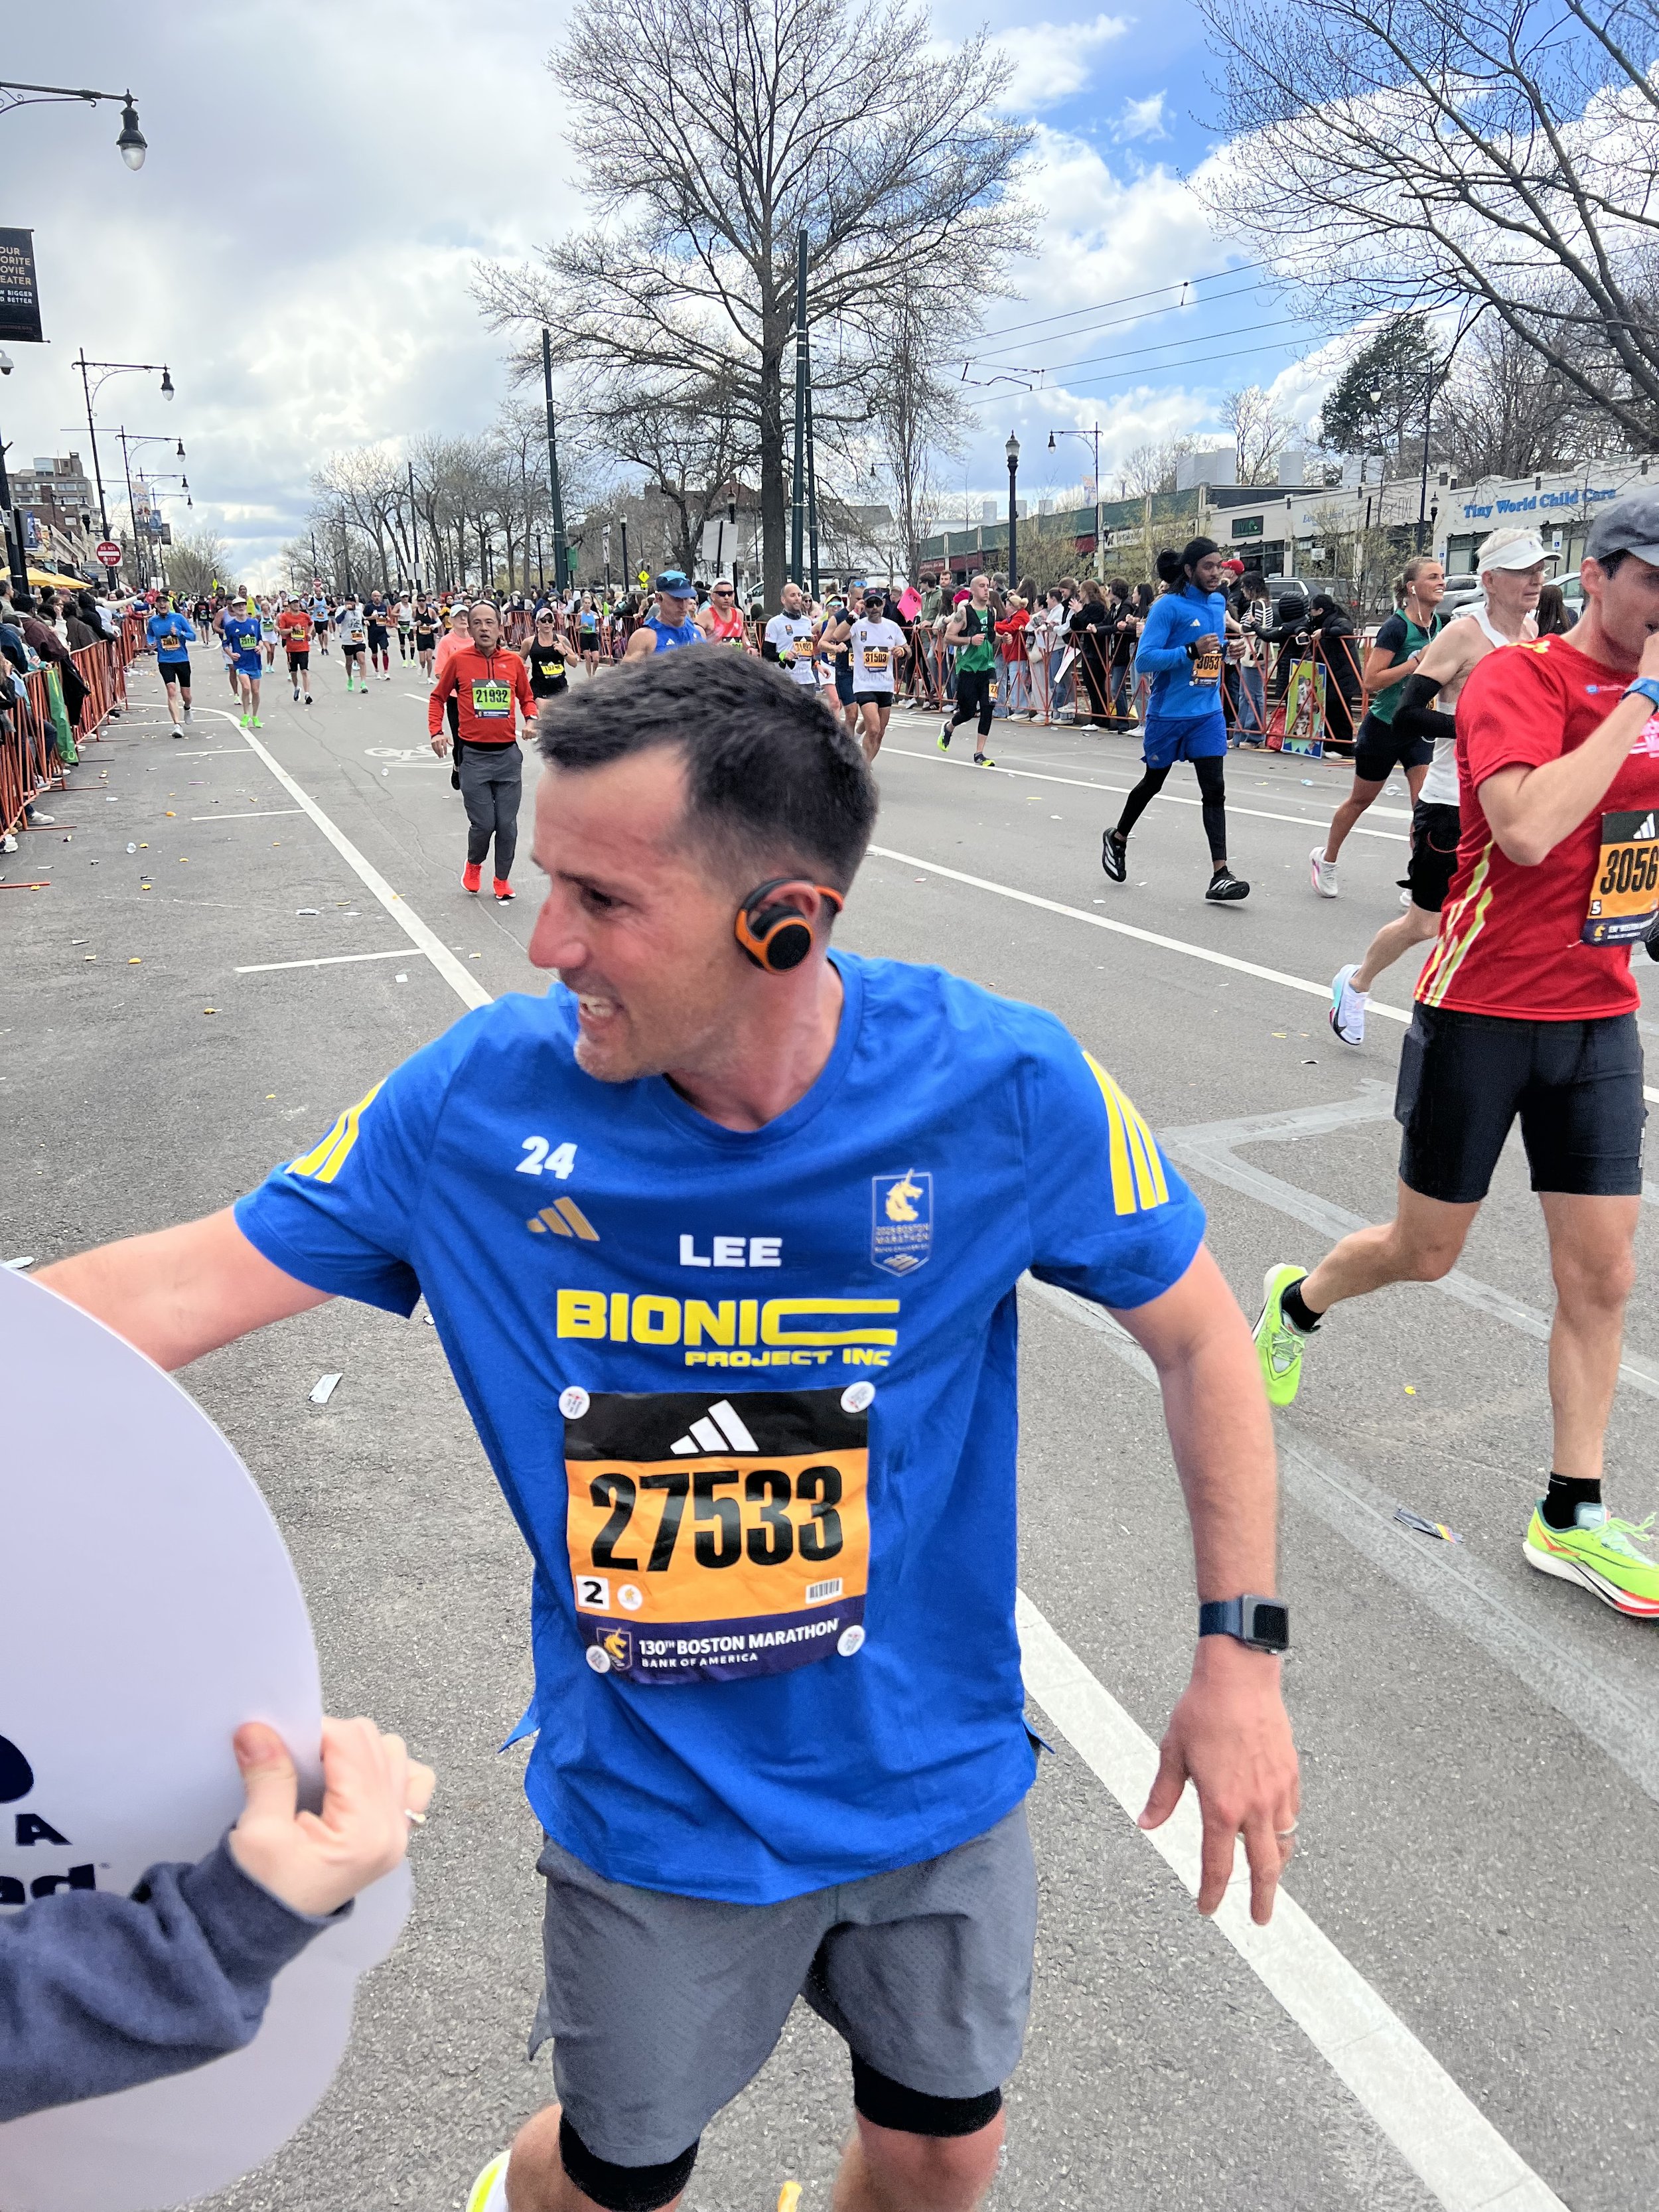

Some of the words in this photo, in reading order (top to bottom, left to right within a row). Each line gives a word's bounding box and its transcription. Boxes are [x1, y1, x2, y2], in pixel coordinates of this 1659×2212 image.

[1464, 504, 1493, 518] Tiny
[1496, 496, 1536, 513] World
[1540, 488, 1579, 508] Child
[1582, 488, 1616, 502] Care
[476, 689, 508, 703] 21932
[516, 1136, 578, 1180] 24
[680, 1234, 782, 1267] LEE
[557, 1288, 900, 1347] BIONIC
[685, 1349, 833, 1367] PROJECT
[843, 1348, 891, 1367] INC
[589, 1465, 843, 1572] 27533
[583, 1581, 603, 1604] 2
[677, 1636, 745, 1655] BOSTON
[749, 1617, 839, 1649] MARATHON
[641, 1657, 677, 1668] BANK
[680, 1657, 697, 1666] OF
[699, 1653, 758, 1666] AMERICA
